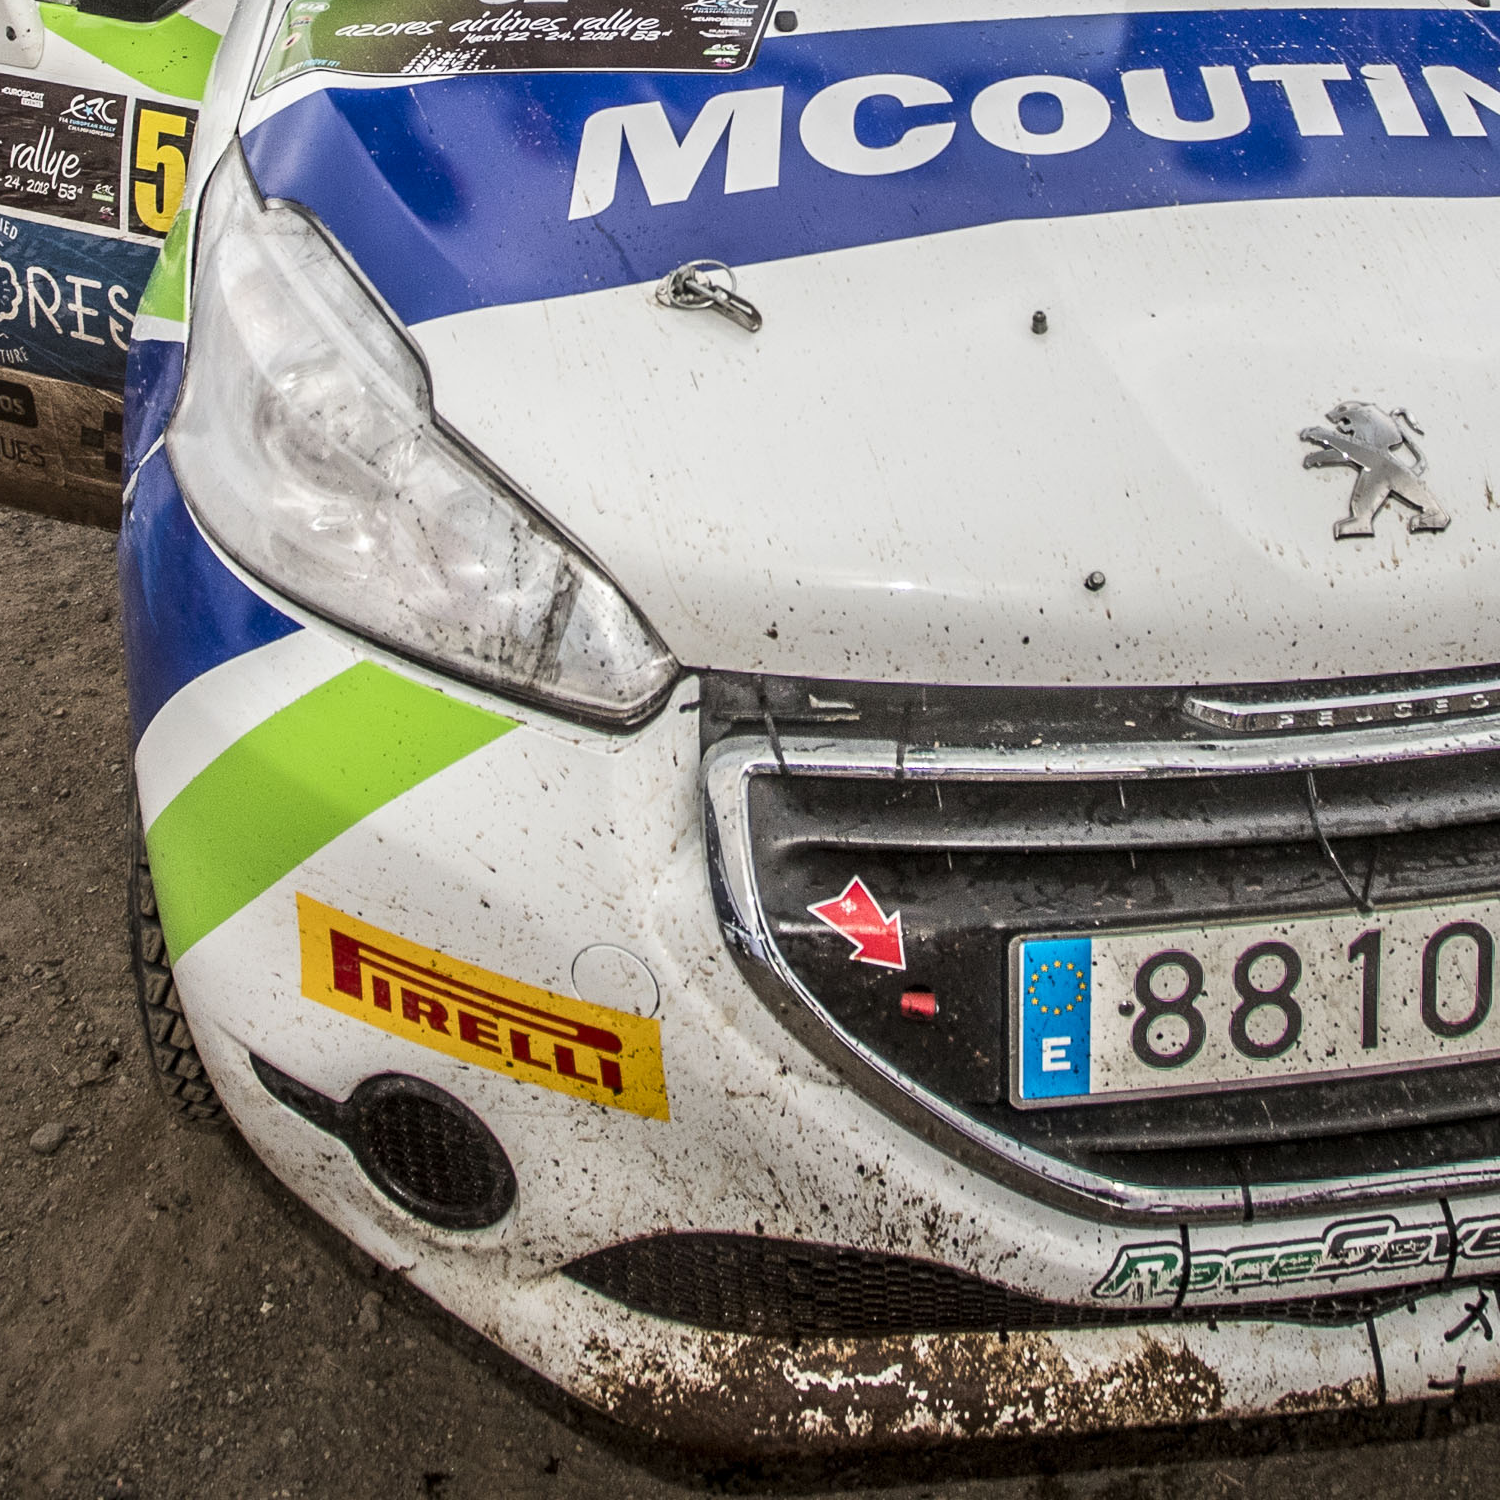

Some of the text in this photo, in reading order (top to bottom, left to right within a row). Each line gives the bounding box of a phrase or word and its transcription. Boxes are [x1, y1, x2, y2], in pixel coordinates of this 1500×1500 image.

[334, 7, 661, 37] azores airlines rallye
[504, 31, 531, 42] 22
[579, 31, 617, 42] 2018
[9, 125, 82, 190] rallye
[26, 178, 50, 196] 2018
[329, 927, 624, 1093] PIRELLI
[1131, 921, 1495, 1070] 8810
[1041, 1035, 1072, 1073] E
